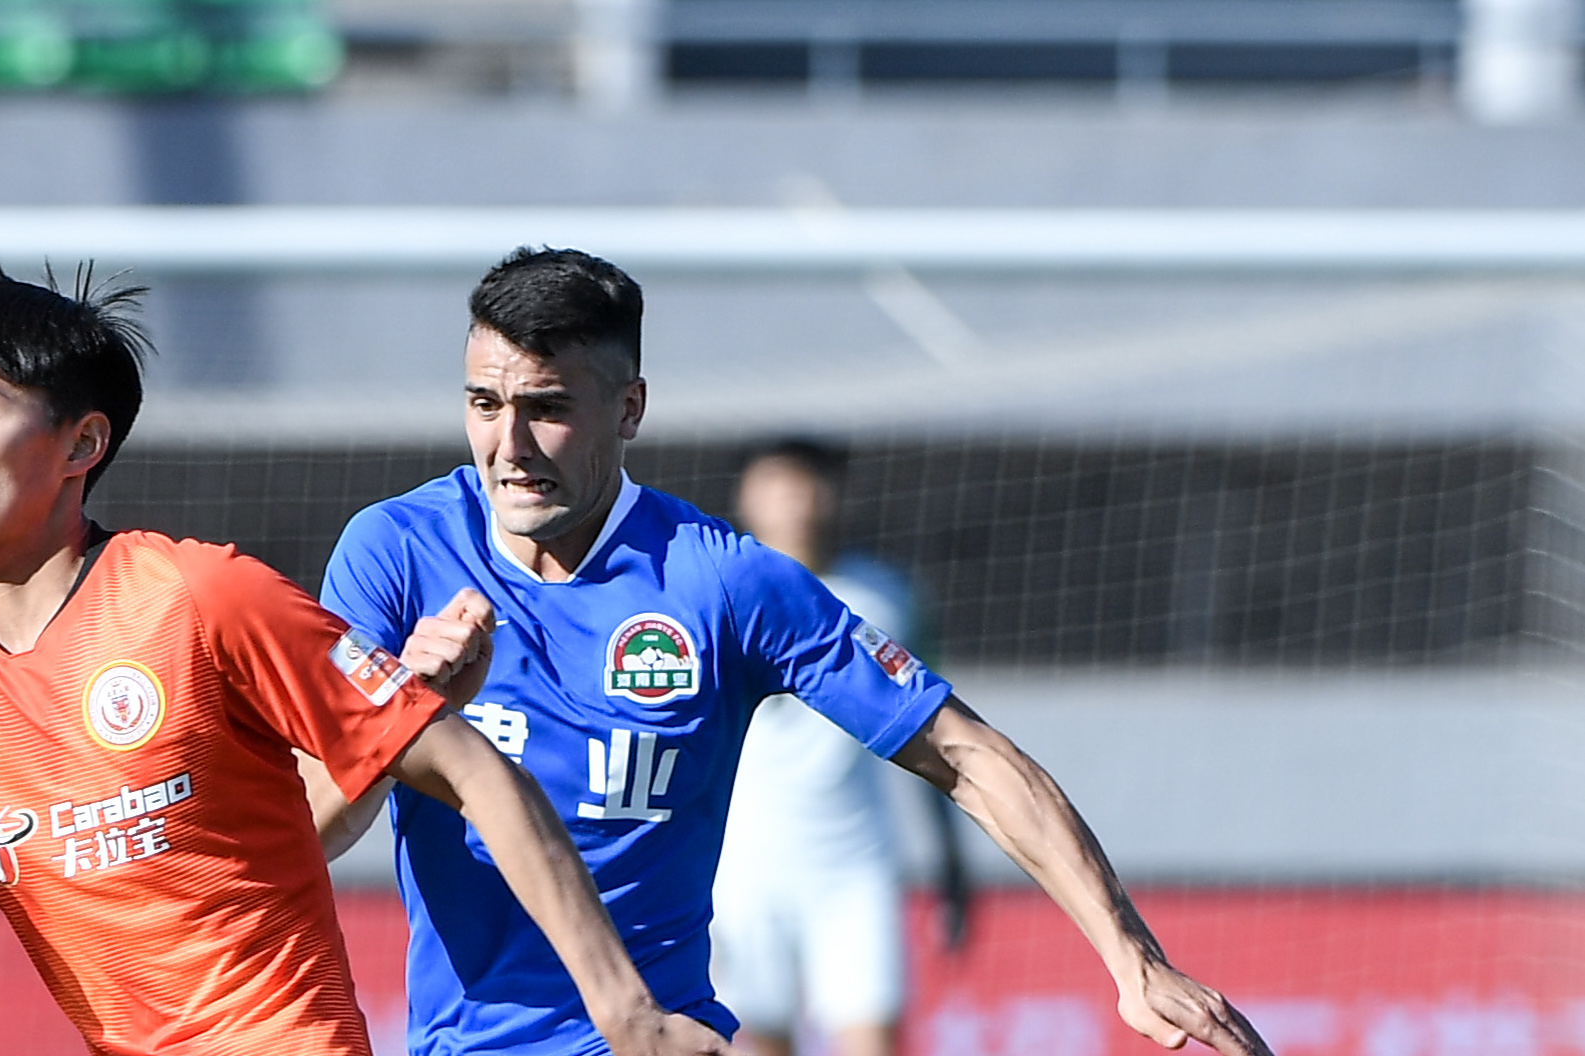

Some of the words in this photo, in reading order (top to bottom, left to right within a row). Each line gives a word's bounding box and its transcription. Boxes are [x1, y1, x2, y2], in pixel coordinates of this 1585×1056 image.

[48, 772, 193, 839] Carabao
[50, 816, 172, 879] 卡拉宝
